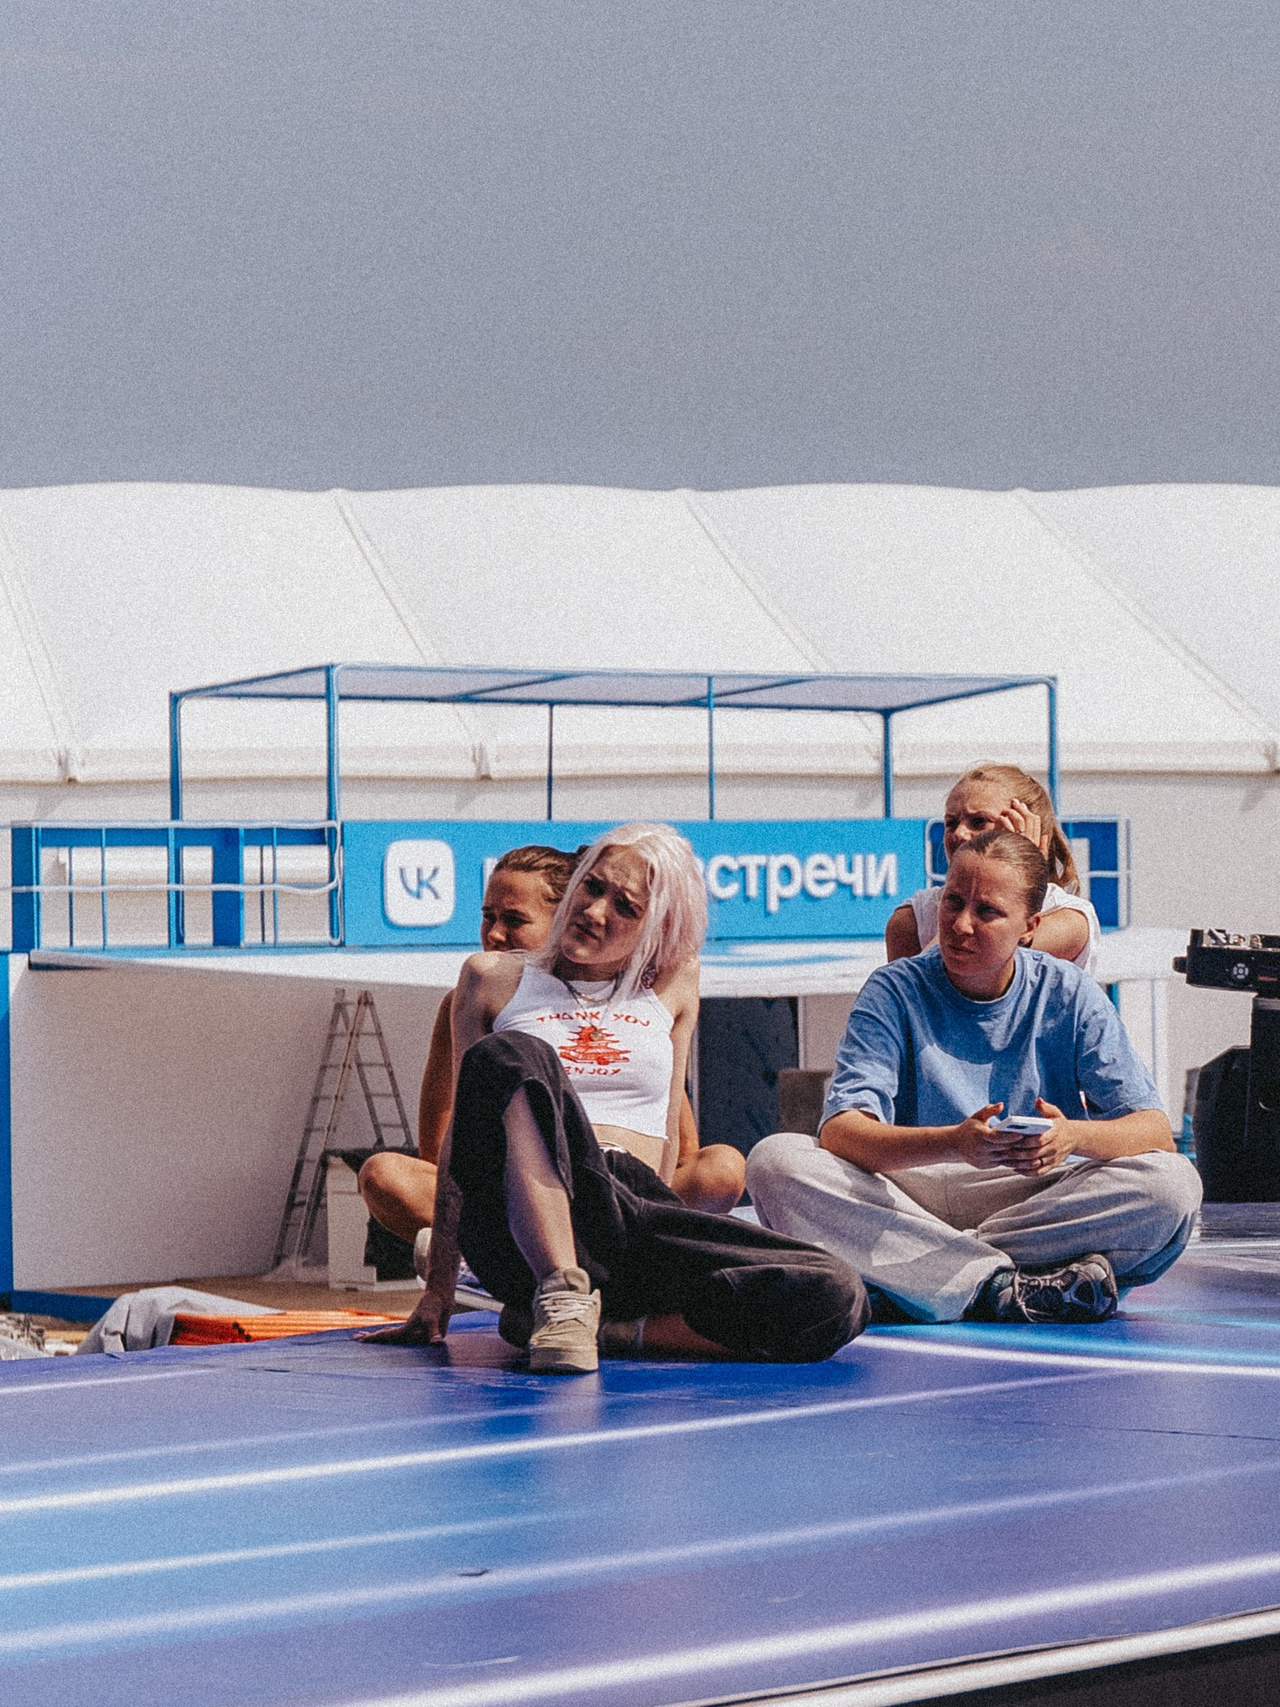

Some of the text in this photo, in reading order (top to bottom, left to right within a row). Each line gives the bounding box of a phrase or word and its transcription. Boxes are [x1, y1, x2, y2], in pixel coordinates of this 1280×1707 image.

[399, 866, 440, 900] VK
[697, 853, 898, 914] стречи
[536, 1011, 650, 1027] THANK YOU
